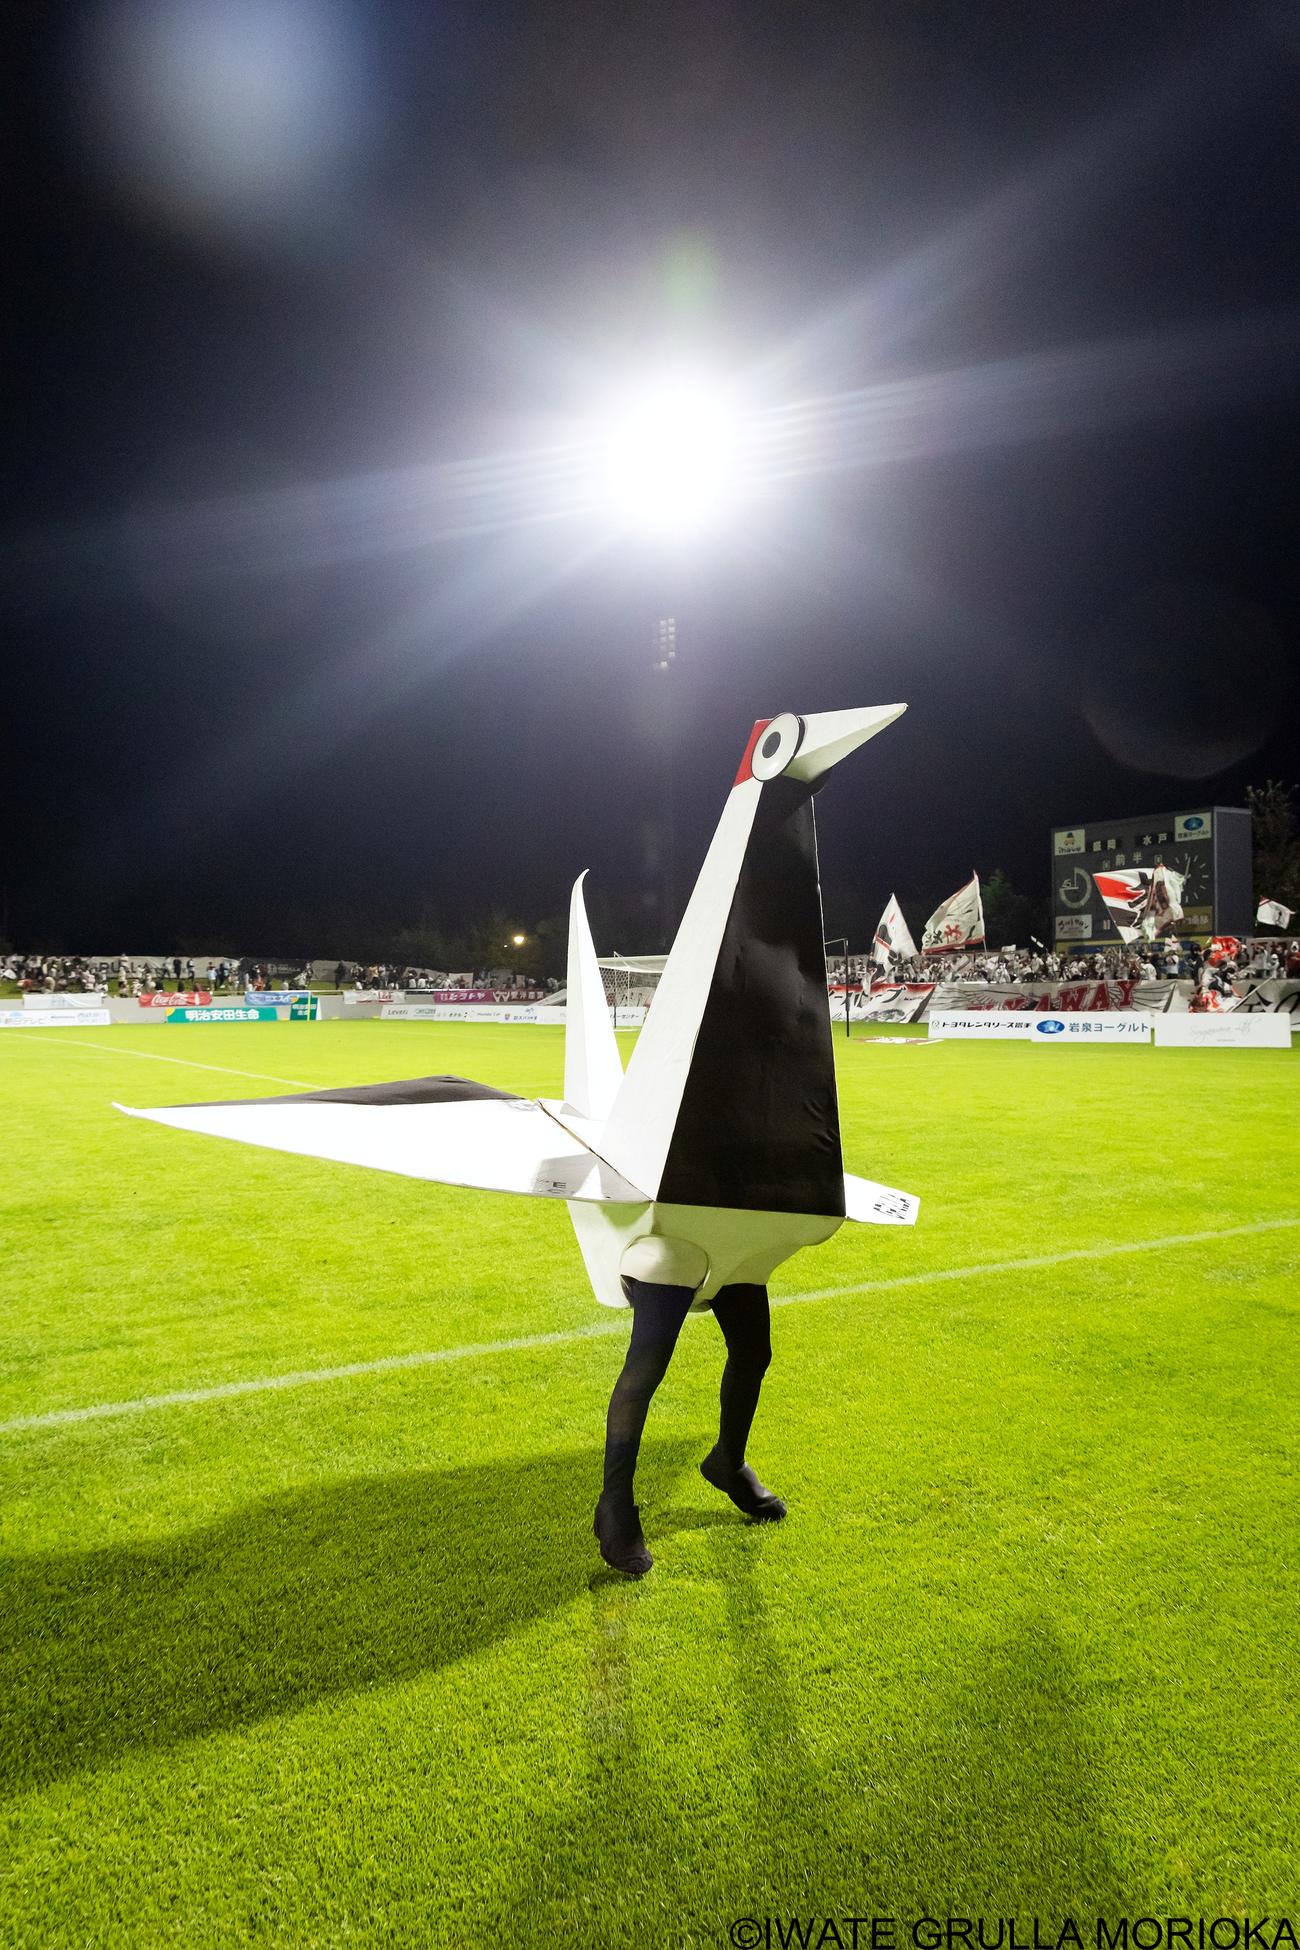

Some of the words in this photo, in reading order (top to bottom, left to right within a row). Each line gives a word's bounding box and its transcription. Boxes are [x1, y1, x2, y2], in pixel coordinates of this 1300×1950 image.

[184, 1008, 260, 1021] 明治安田生命
[1069, 1022, 1149, 1033] 岩泉ヨーグルト
